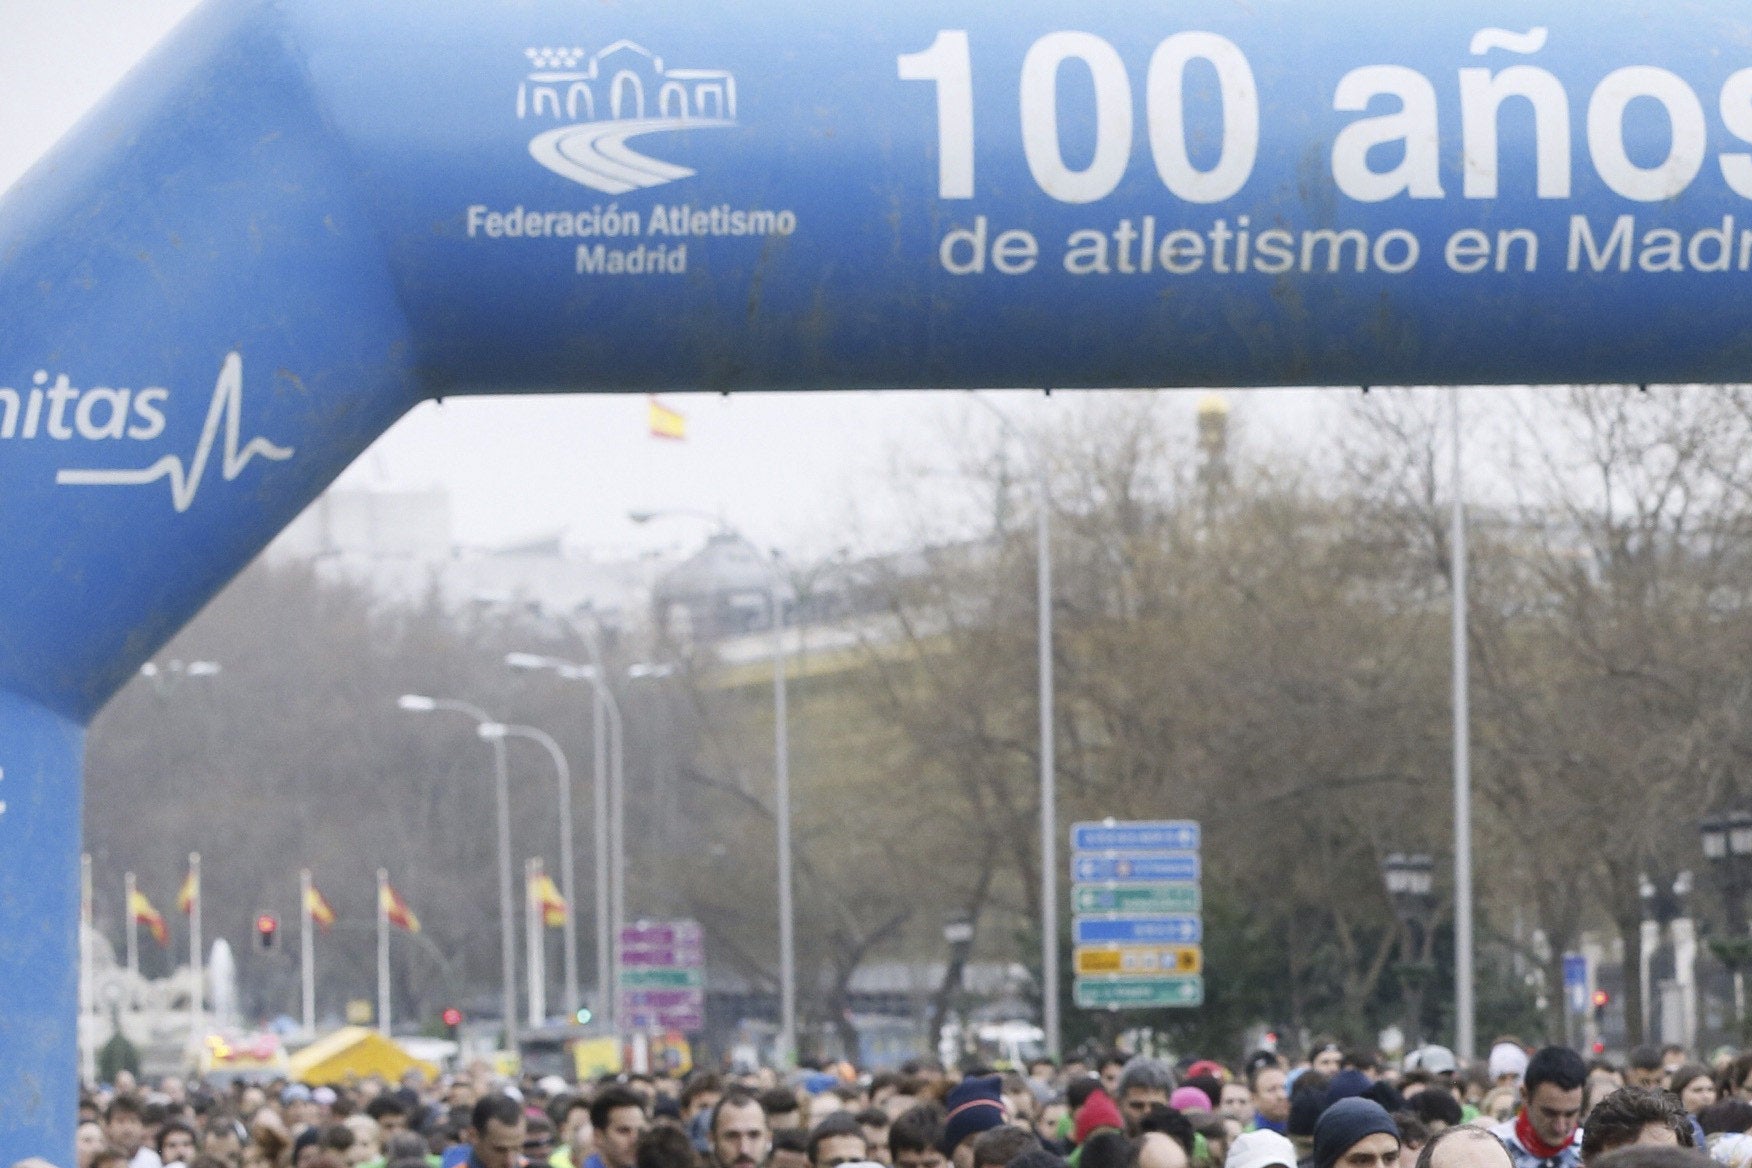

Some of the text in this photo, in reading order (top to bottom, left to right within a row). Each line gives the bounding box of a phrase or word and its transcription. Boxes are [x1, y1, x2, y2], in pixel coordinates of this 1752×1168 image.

[897, 29, 1260, 204] 100
[467, 203, 797, 238] Federación Atletismo
[576, 244, 687, 275] Madrid
[939, 216, 1040, 275] de
[1064, 216, 1419, 275] atletismo
[1445, 225, 1538, 273] en
